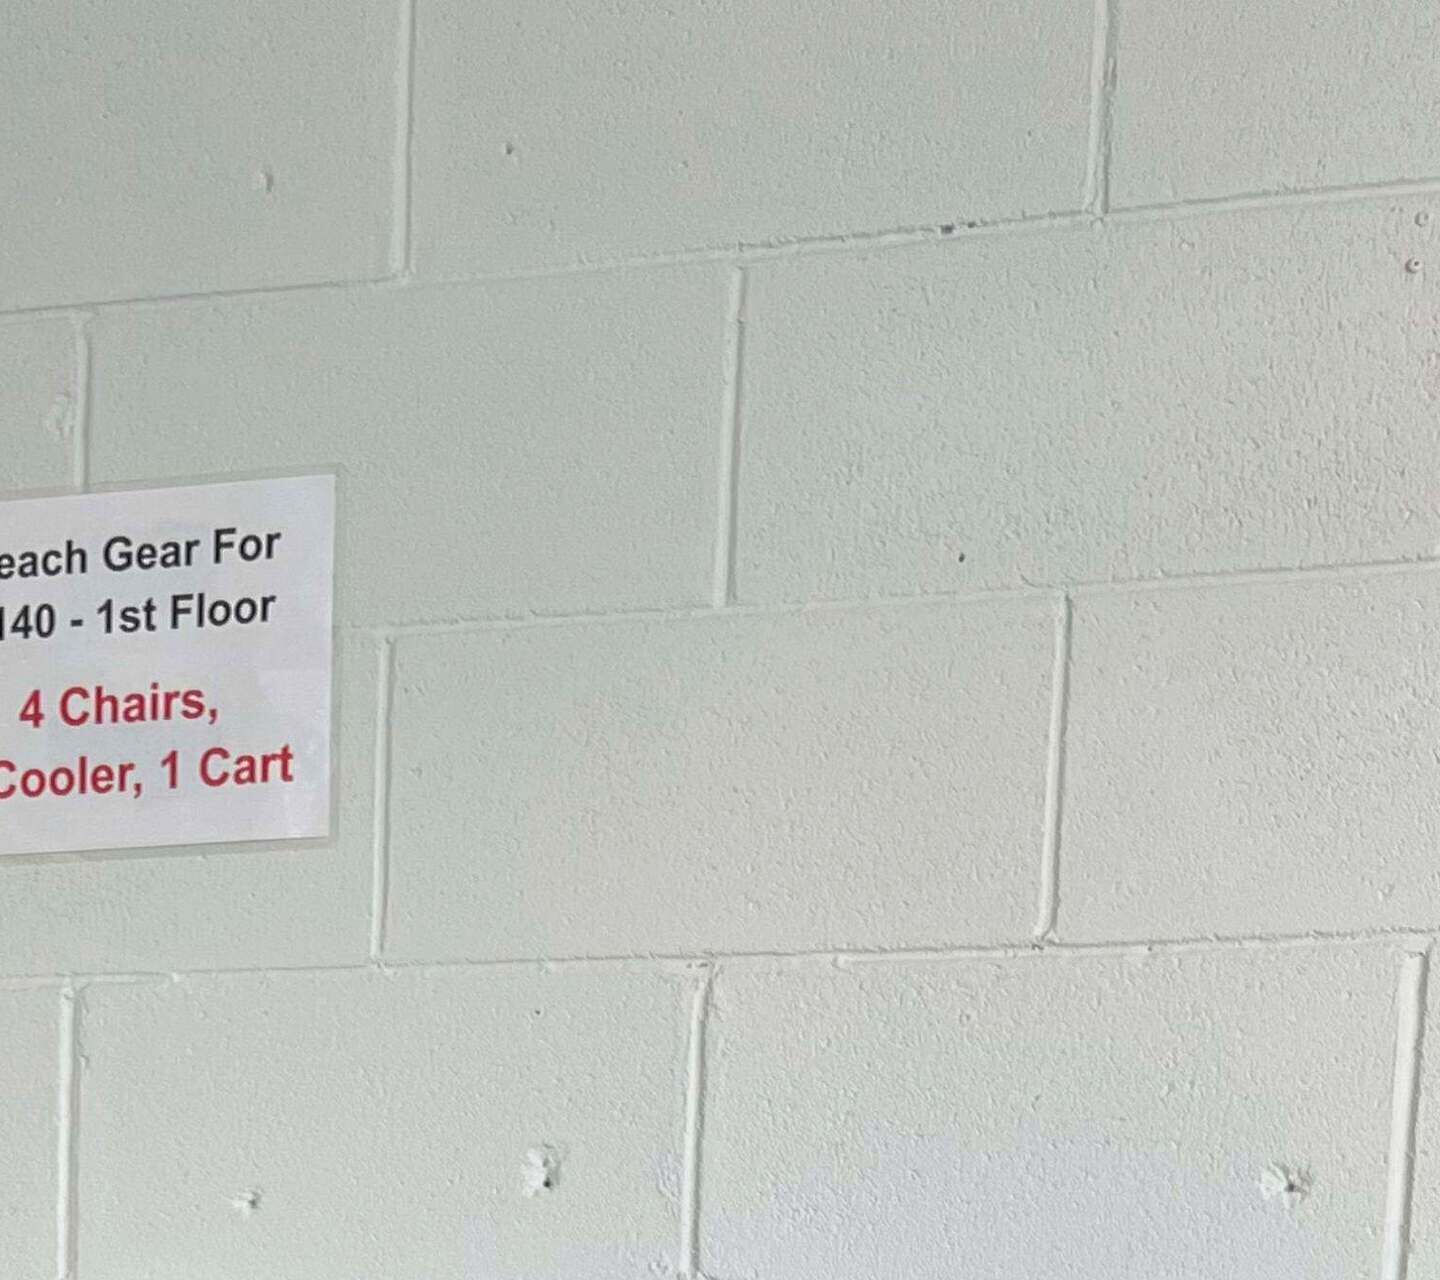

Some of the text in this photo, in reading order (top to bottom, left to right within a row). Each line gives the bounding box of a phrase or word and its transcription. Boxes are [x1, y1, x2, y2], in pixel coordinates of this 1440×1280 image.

[102, 535, 201, 572] Gear
[213, 527, 282, 564] For
[70, 618, 84, 627] -
[97, 597, 157, 634] 1st
[171, 592, 277, 630] Floor
[19, 682, 217, 728] 4 Chairs,
[161, 750, 178, 789] 1
[200, 744, 293, 787] Cart
